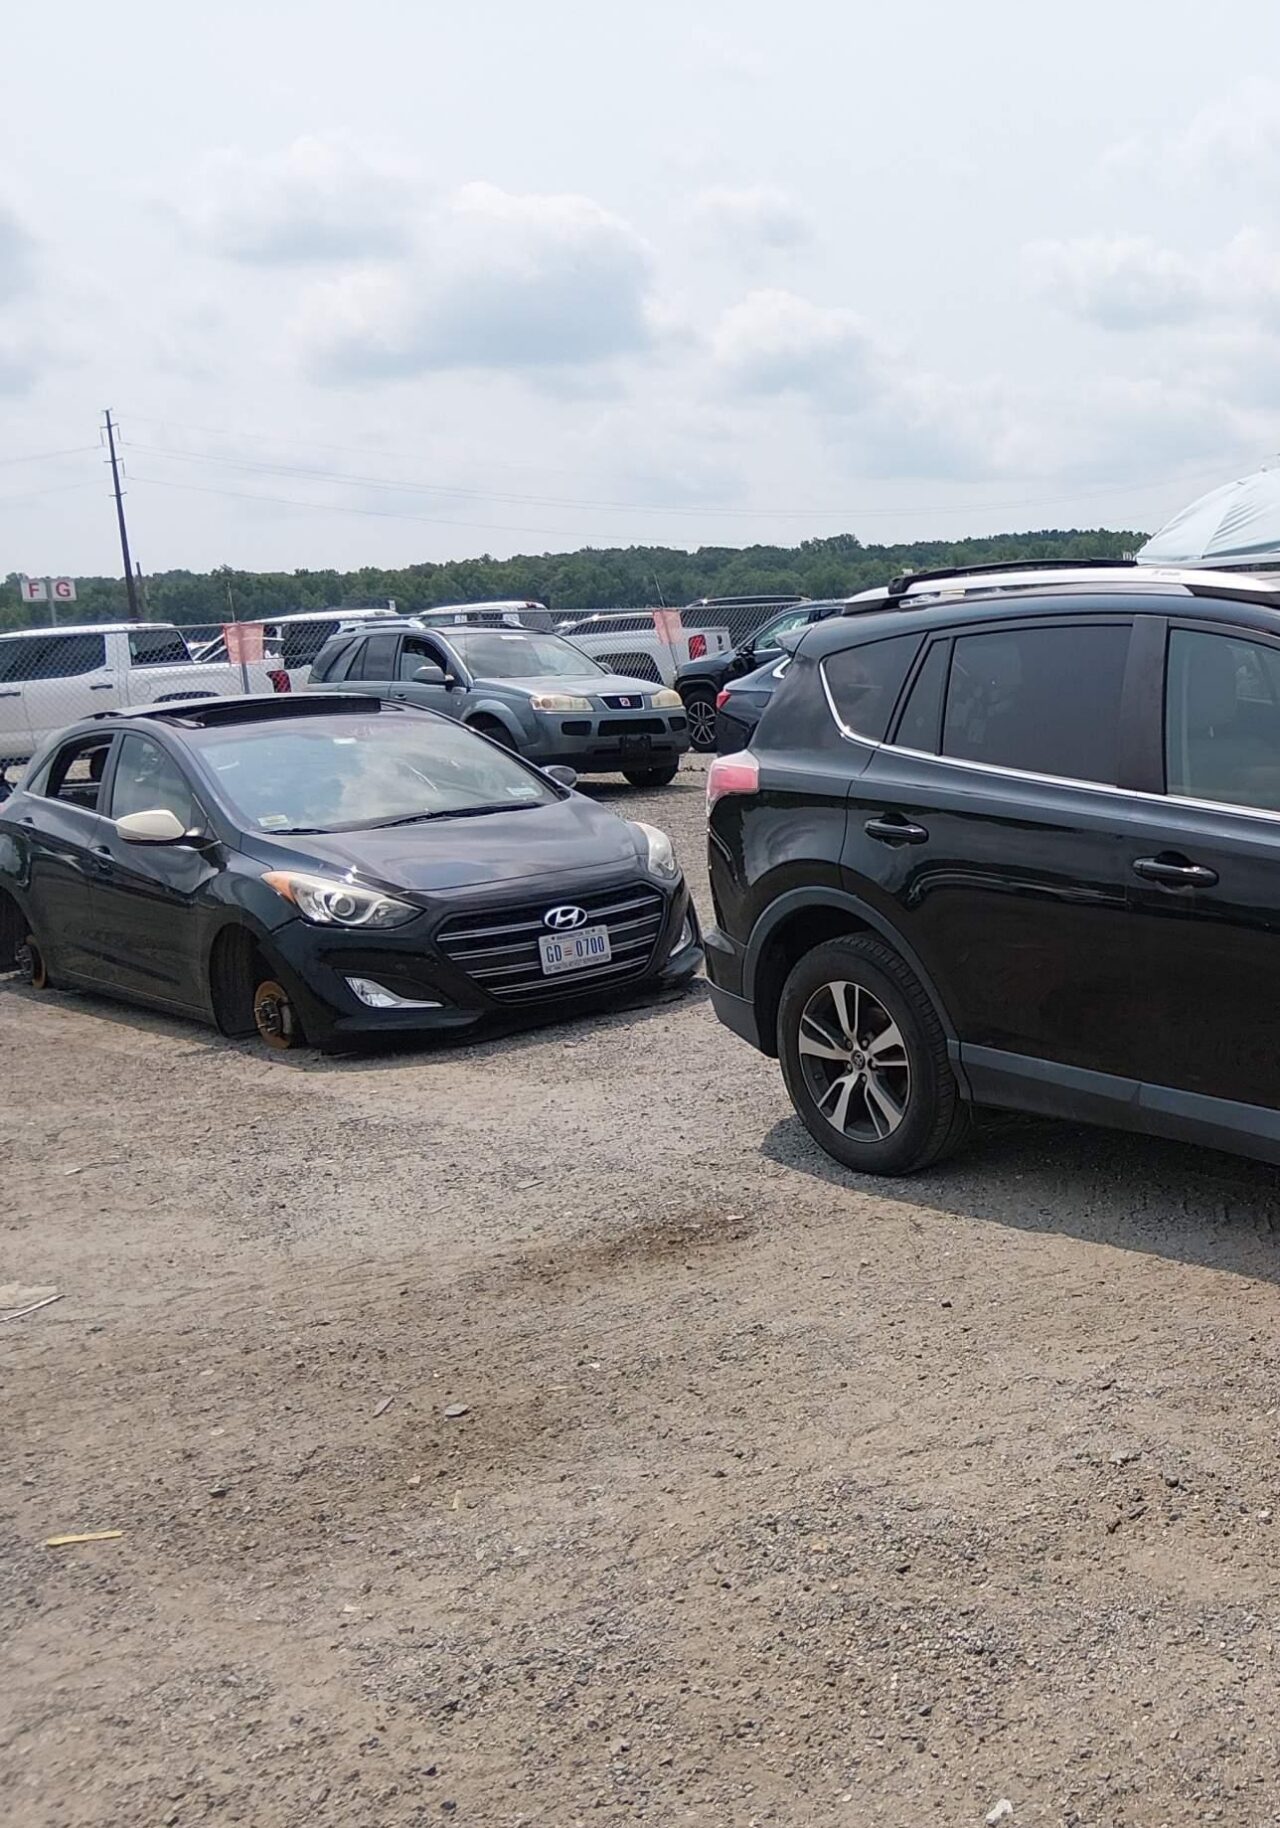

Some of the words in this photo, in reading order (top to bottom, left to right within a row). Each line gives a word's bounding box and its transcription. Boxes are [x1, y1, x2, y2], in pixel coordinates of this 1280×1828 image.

[28, 583, 40, 597] F
[56, 582, 71, 597] G
[546, 944, 563, 963] GD
[576, 936, 605, 957] 0700
